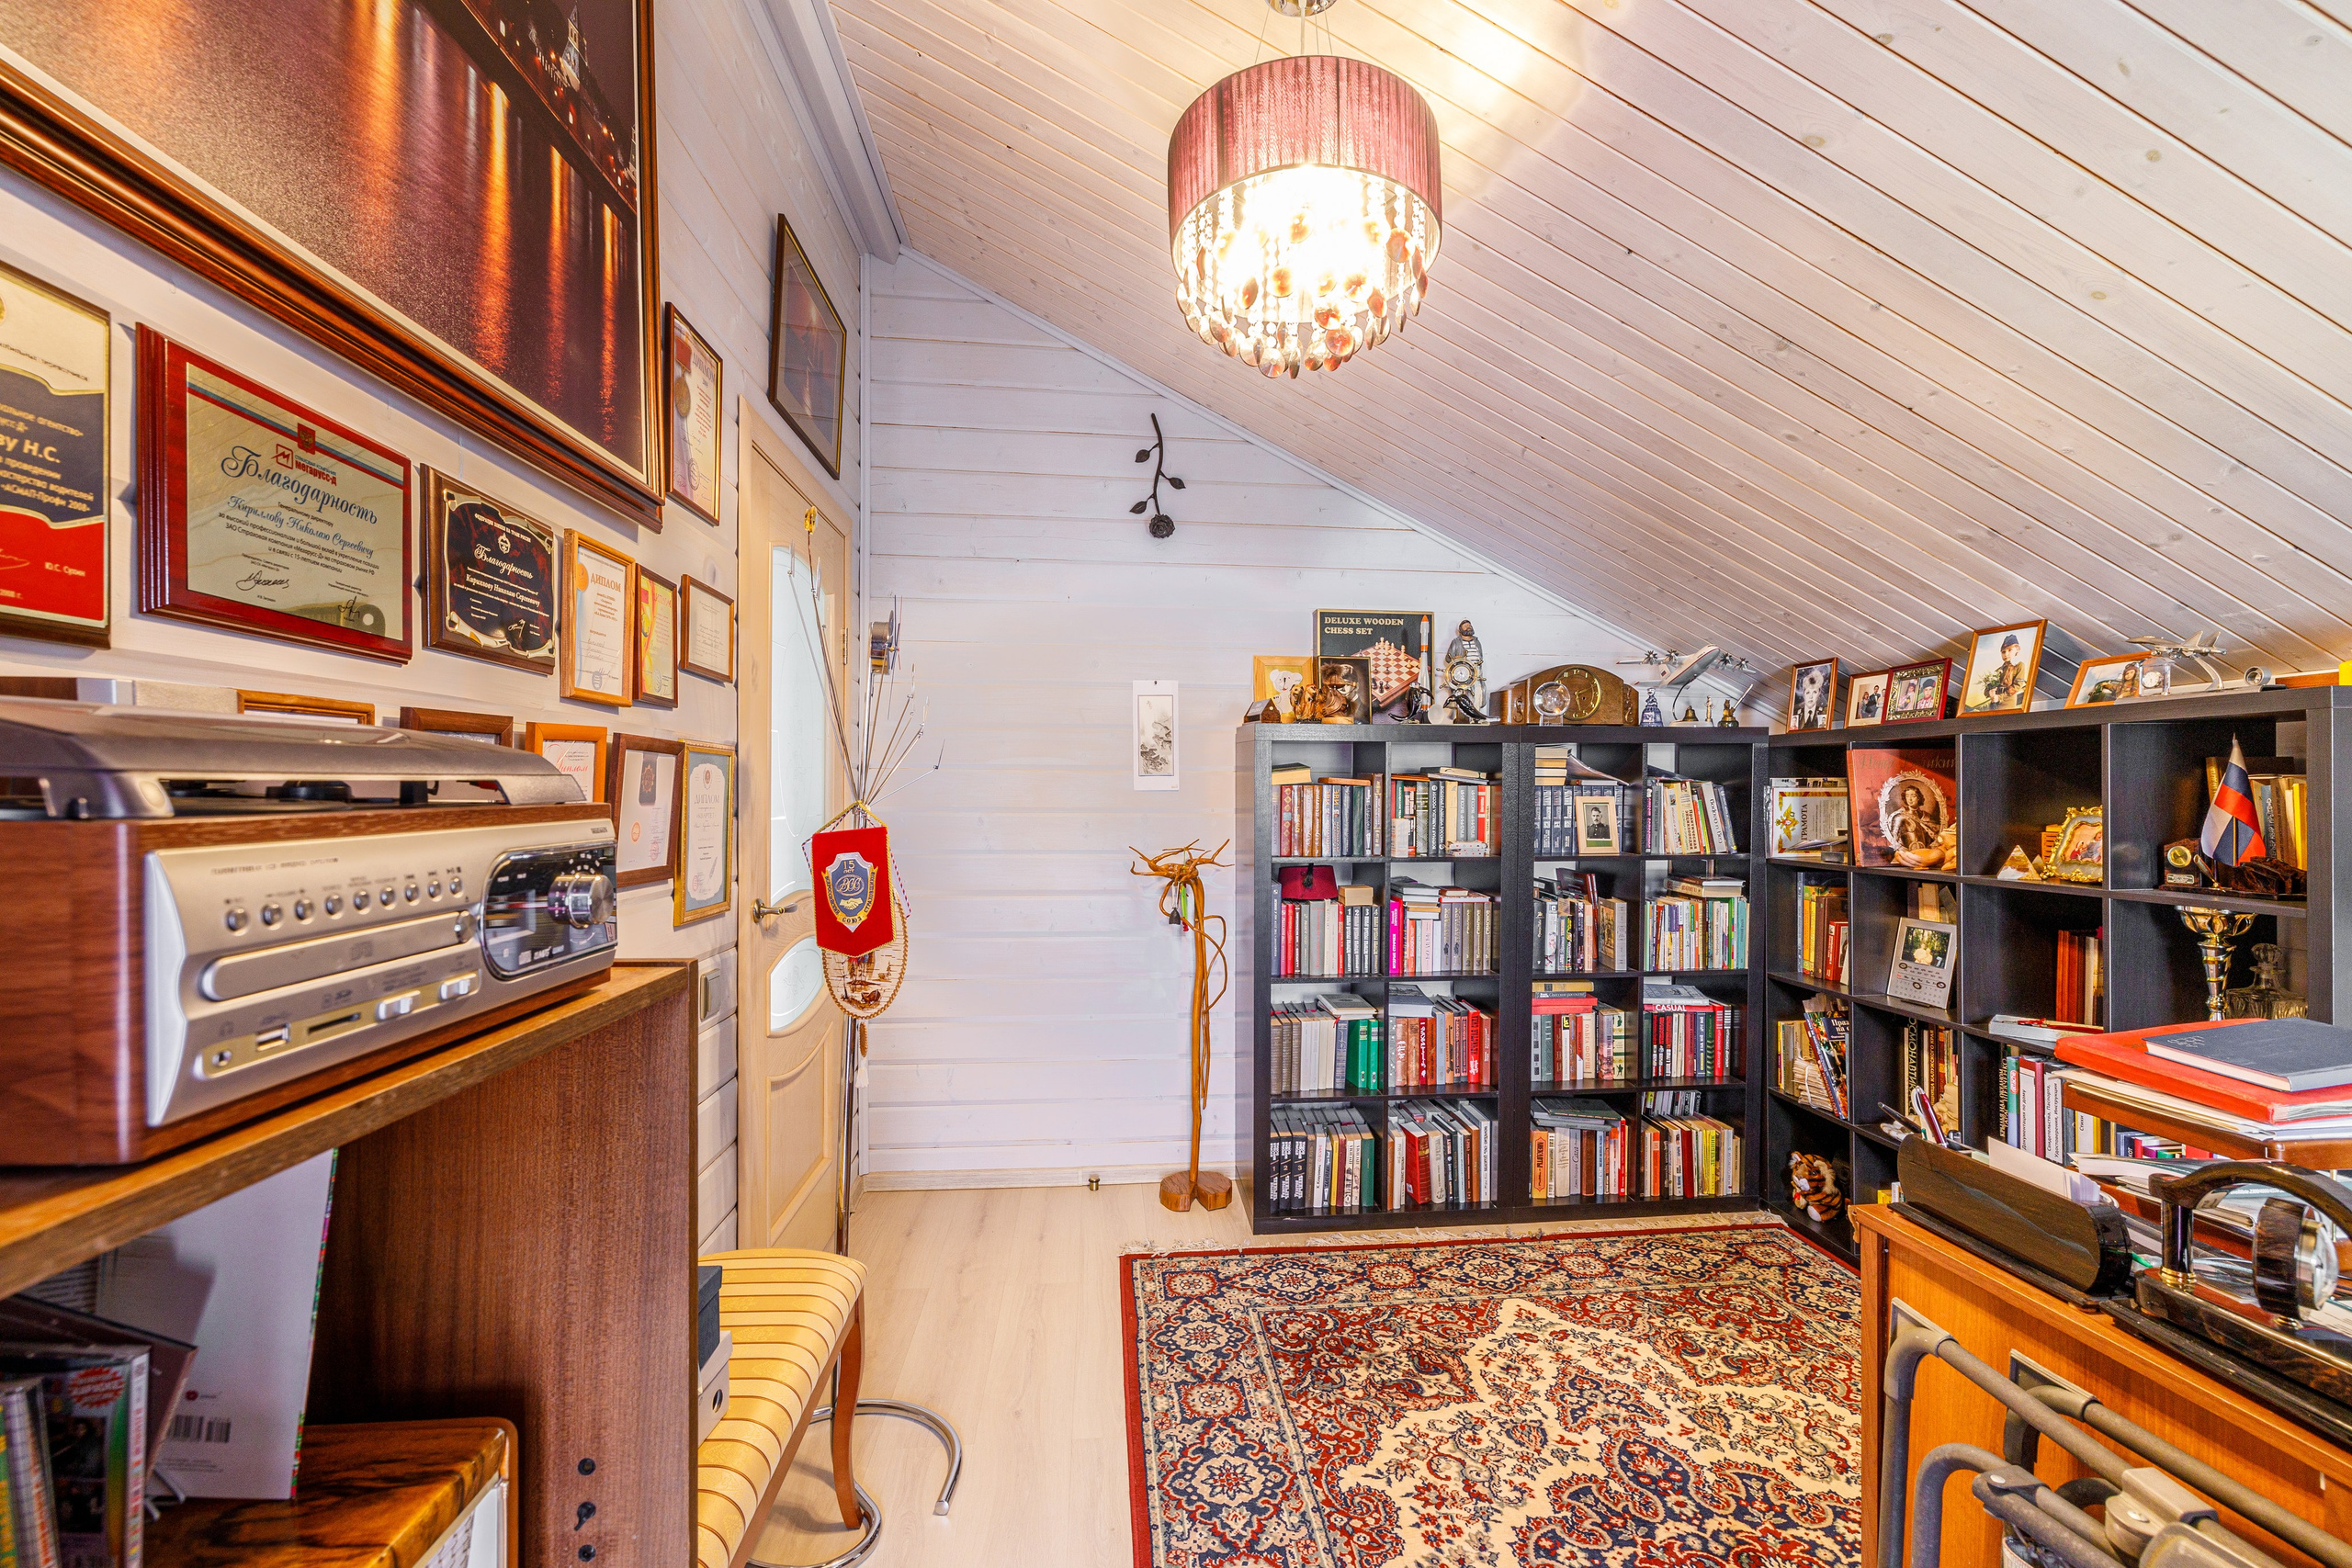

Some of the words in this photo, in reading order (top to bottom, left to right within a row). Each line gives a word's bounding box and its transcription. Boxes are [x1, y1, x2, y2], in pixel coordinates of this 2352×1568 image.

[23, 439, 61, 464] Н.С.
[220, 446, 378, 525] Благодарность
[225, 522, 237, 531] ЗАО
[227, 495, 284, 528] Кириллову
[286, 514, 331, 542] Николаю
[474, 543, 533, 580] Благодарность
[466, 573, 494, 592] Кириллову
[590, 572, 621, 593] ДИПЛОМ
[1324, 616, 1362, 625] DELUXE
[1363, 617, 1404, 626] WOODEN
[694, 794, 720, 805] ДИПЛОМ
[843, 860, 855, 870] 15
[842, 916, 863, 924] СОЮЗ
[1908, 1017, 1917, 1097] ОСМОНАВТИК
